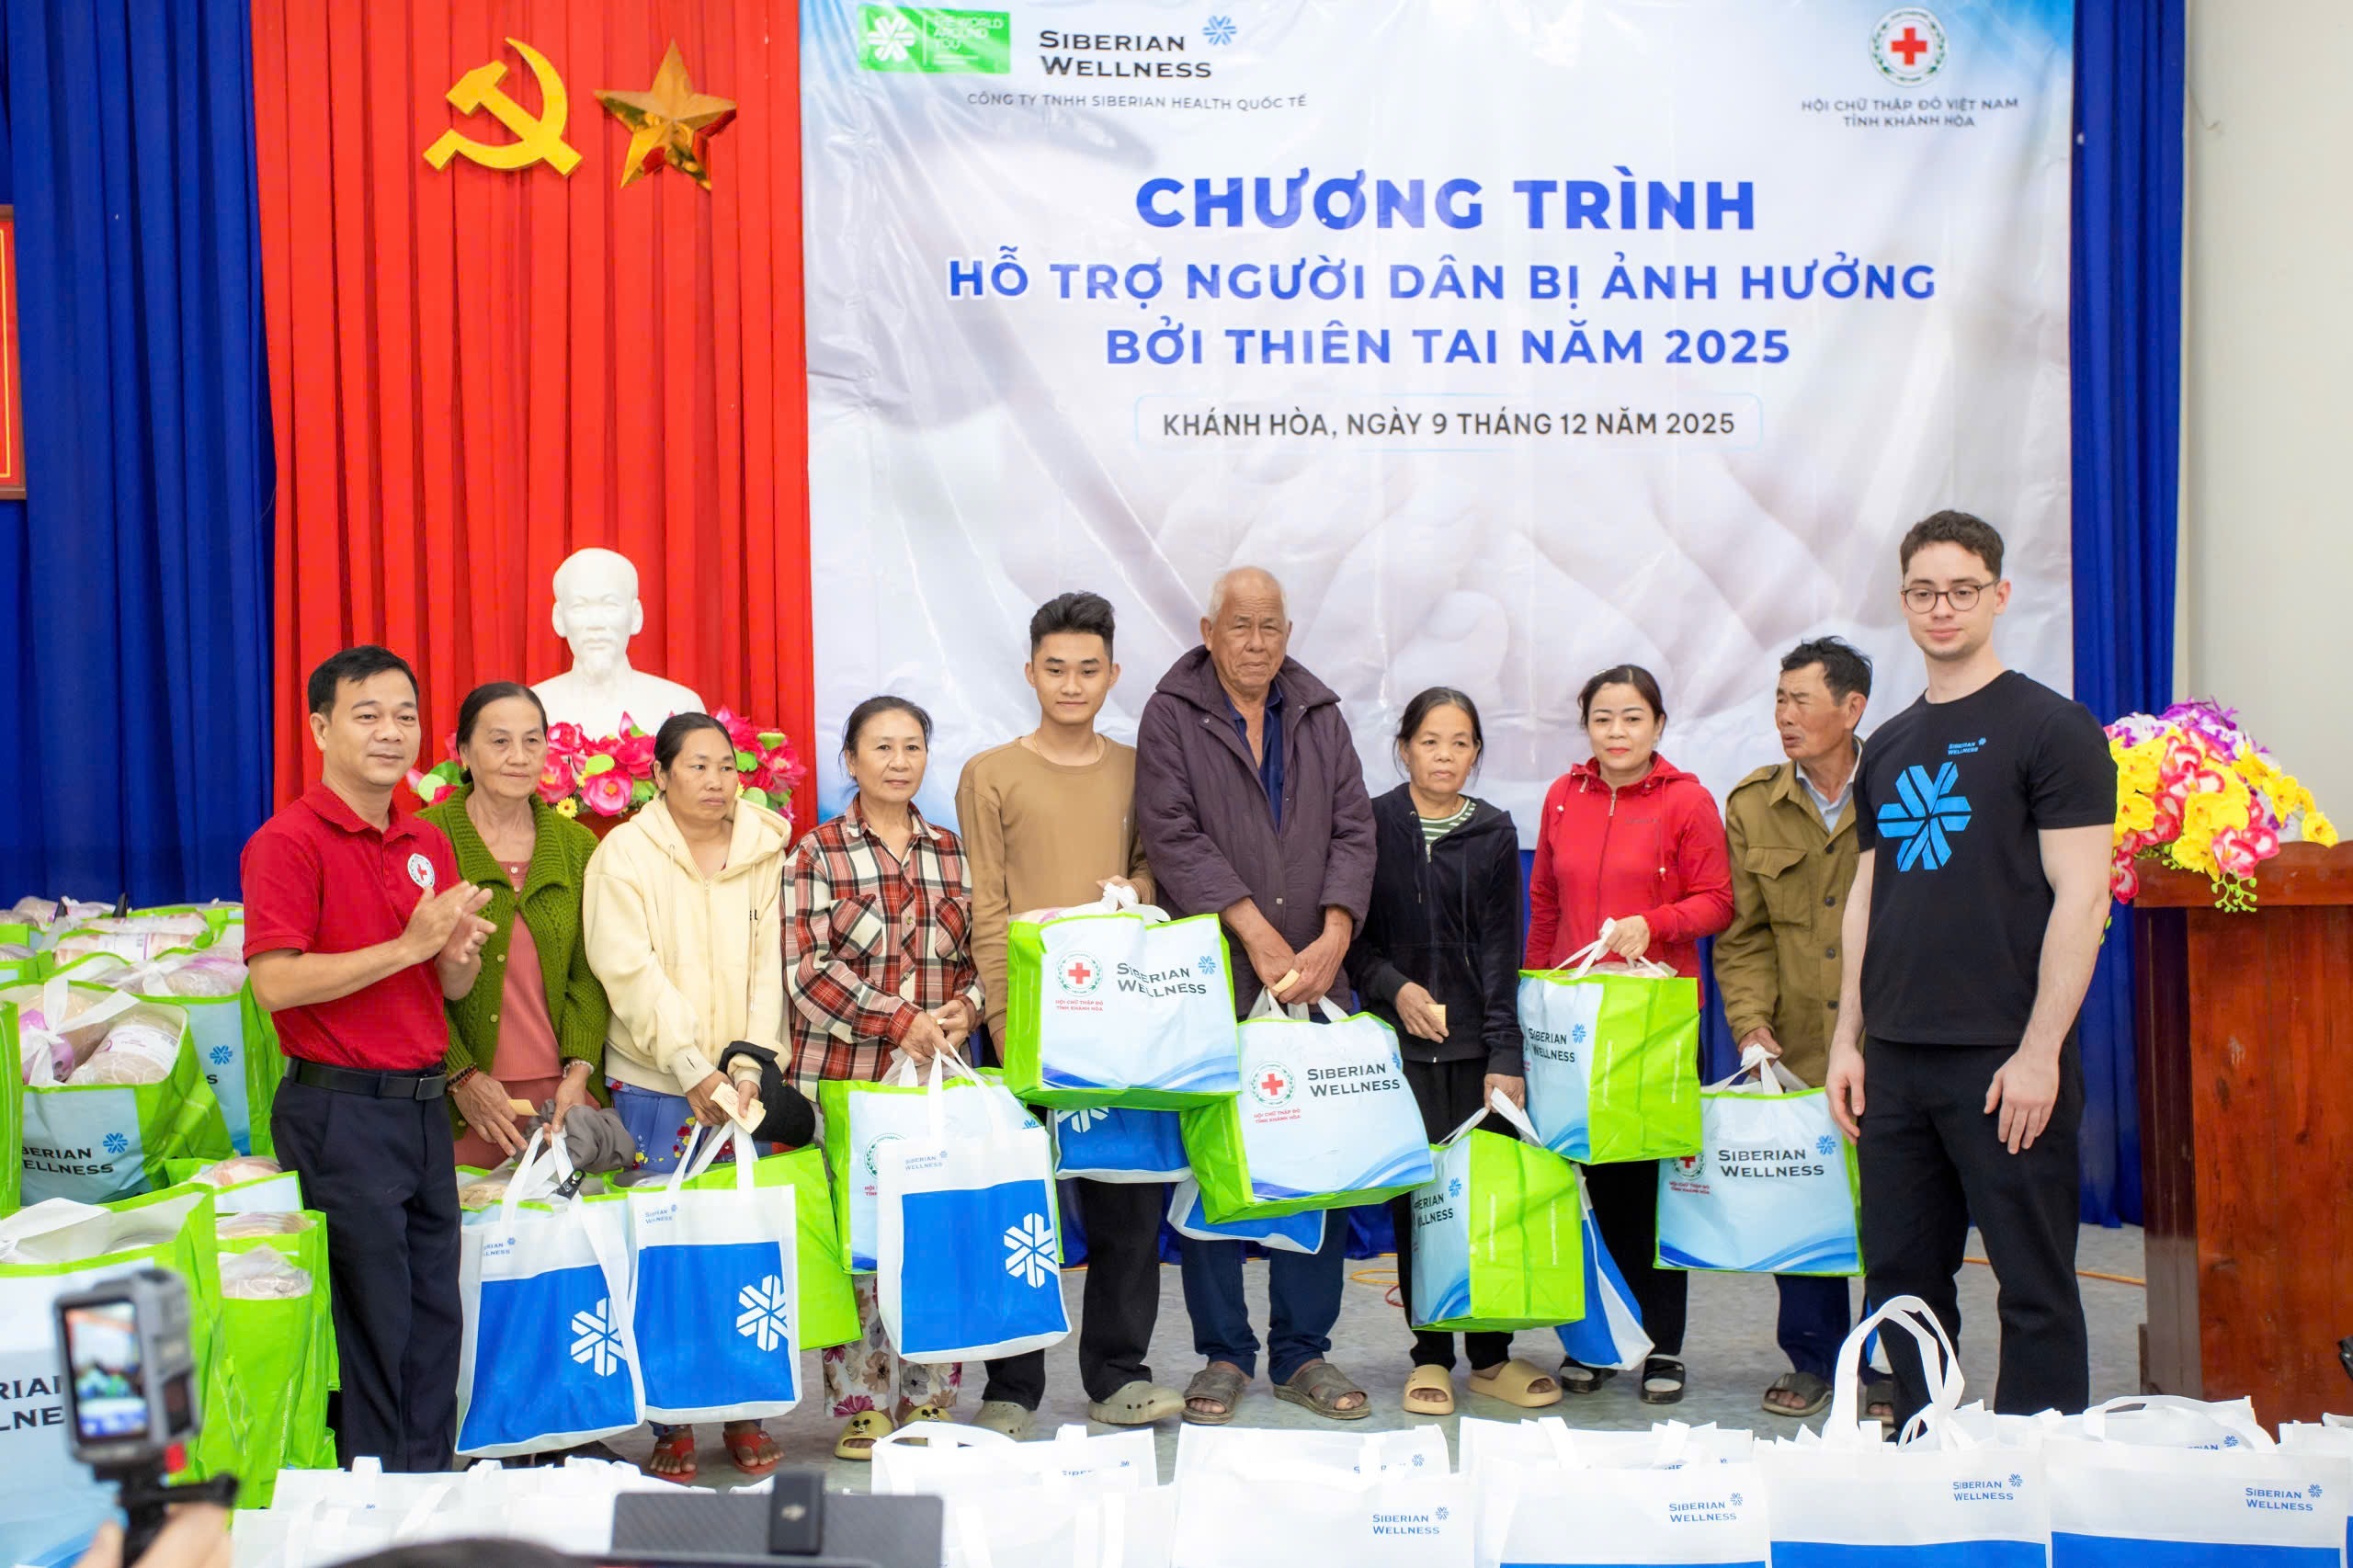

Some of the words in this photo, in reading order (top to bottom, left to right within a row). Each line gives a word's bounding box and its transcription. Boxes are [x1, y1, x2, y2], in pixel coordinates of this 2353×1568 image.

[1040, 30, 1184, 51] SIBERIAN
[1040, 55, 1211, 78] WELLNESS
[967, 92, 1013, 105] CÔNG
[1018, 94, 1037, 106] TY
[1042, 94, 1086, 107] TNHH
[1092, 96, 1165, 108] SIBERIAN
[1172, 97, 1232, 109] HEALTH
[1236, 95, 1283, 111] QUỐC
[1981, 97, 2019, 109] NAM
[1136, 167, 1483, 230] CHƯƠNG
[1513, 165, 1755, 230] TRÌNH
[949, 245, 1029, 297] HỖ
[1050, 256, 1163, 310] TRỢ
[1187, 255, 1364, 301] NGƯỜI
[1391, 255, 1504, 300] DÂN
[1529, 265, 1578, 310] BỊ
[1601, 251, 1717, 300] ẢNH
[1742, 251, 1936, 300] HƯỞNG
[1108, 315, 1202, 365] BỞI
[1225, 320, 1390, 365] THIÊN
[1413, 328, 1496, 364] TAI
[1522, 319, 1643, 364] NĂM
[1665, 329, 1790, 365] 2025
[1164, 406, 1260, 437] KHÁNH
[1269, 406, 1337, 438] HÒA,
[1347, 405, 1422, 435] NGÀY
[1432, 412, 1448, 435] 9
[1457, 405, 1552, 435] THÁNG
[1560, 413, 1587, 435] 12
[1597, 406, 1657, 435] NĂM
[1666, 412, 1734, 435] 2025
[1117, 962, 1190, 983] SIBERIAN
[1118, 979, 1207, 997] WELLNESS
[1529, 1028, 1567, 1045] SIBERIAN
[1532, 1043, 1575, 1062] WELLNESS
[1307, 1063, 1386, 1081] SIBERIAN
[1310, 1079, 1401, 1097] WELLNESS
[22, 1146, 92, 1160] BERIAN
[1718, 1149, 1806, 1162] SIBERIAN
[22, 1159, 114, 1176] ELLNESS
[1720, 1165, 1824, 1177] WELLNESS
[1414, 1194, 1444, 1210] ERIAN
[1413, 1208, 1454, 1229] LLNESS
[1952, 1481, 2002, 1490] SIBERIAN
[2245, 1487, 2302, 1499] SIBERIAN
[1954, 1493, 2014, 1501] WELLNESS
[2246, 1499, 2313, 1511] WELLNESS
[1669, 1502, 1726, 1512] SIBERIAN
[1372, 1514, 1429, 1523] SIBERIAN
[1670, 1513, 1737, 1523] WELLNESS
[1373, 1526, 1440, 1535] WELLNESS
